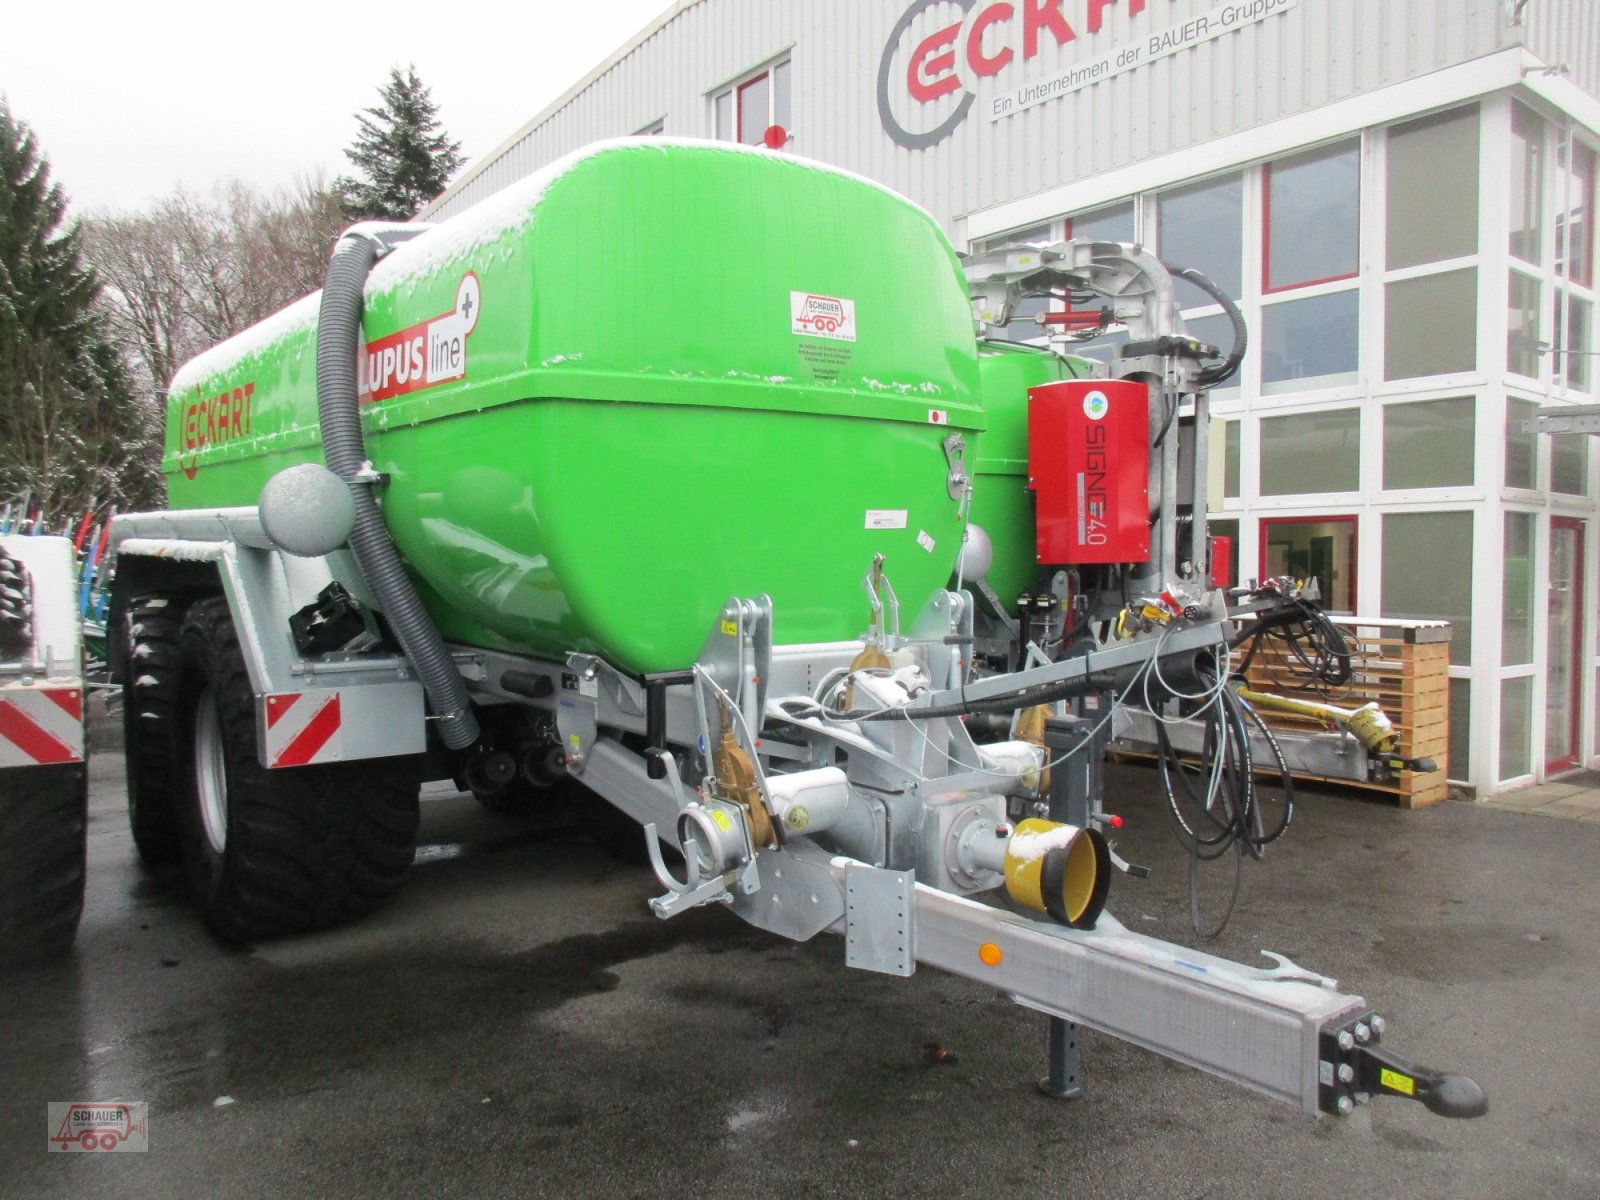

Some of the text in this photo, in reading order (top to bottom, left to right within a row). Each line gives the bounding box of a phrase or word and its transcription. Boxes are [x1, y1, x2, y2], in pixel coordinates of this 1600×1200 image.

[993, 96, 1012, 115] Ein
[1017, 60, 1110, 105] Unternehmen
[1117, 47, 1142, 68] der
[808, 300, 840, 313] SCHAUER
